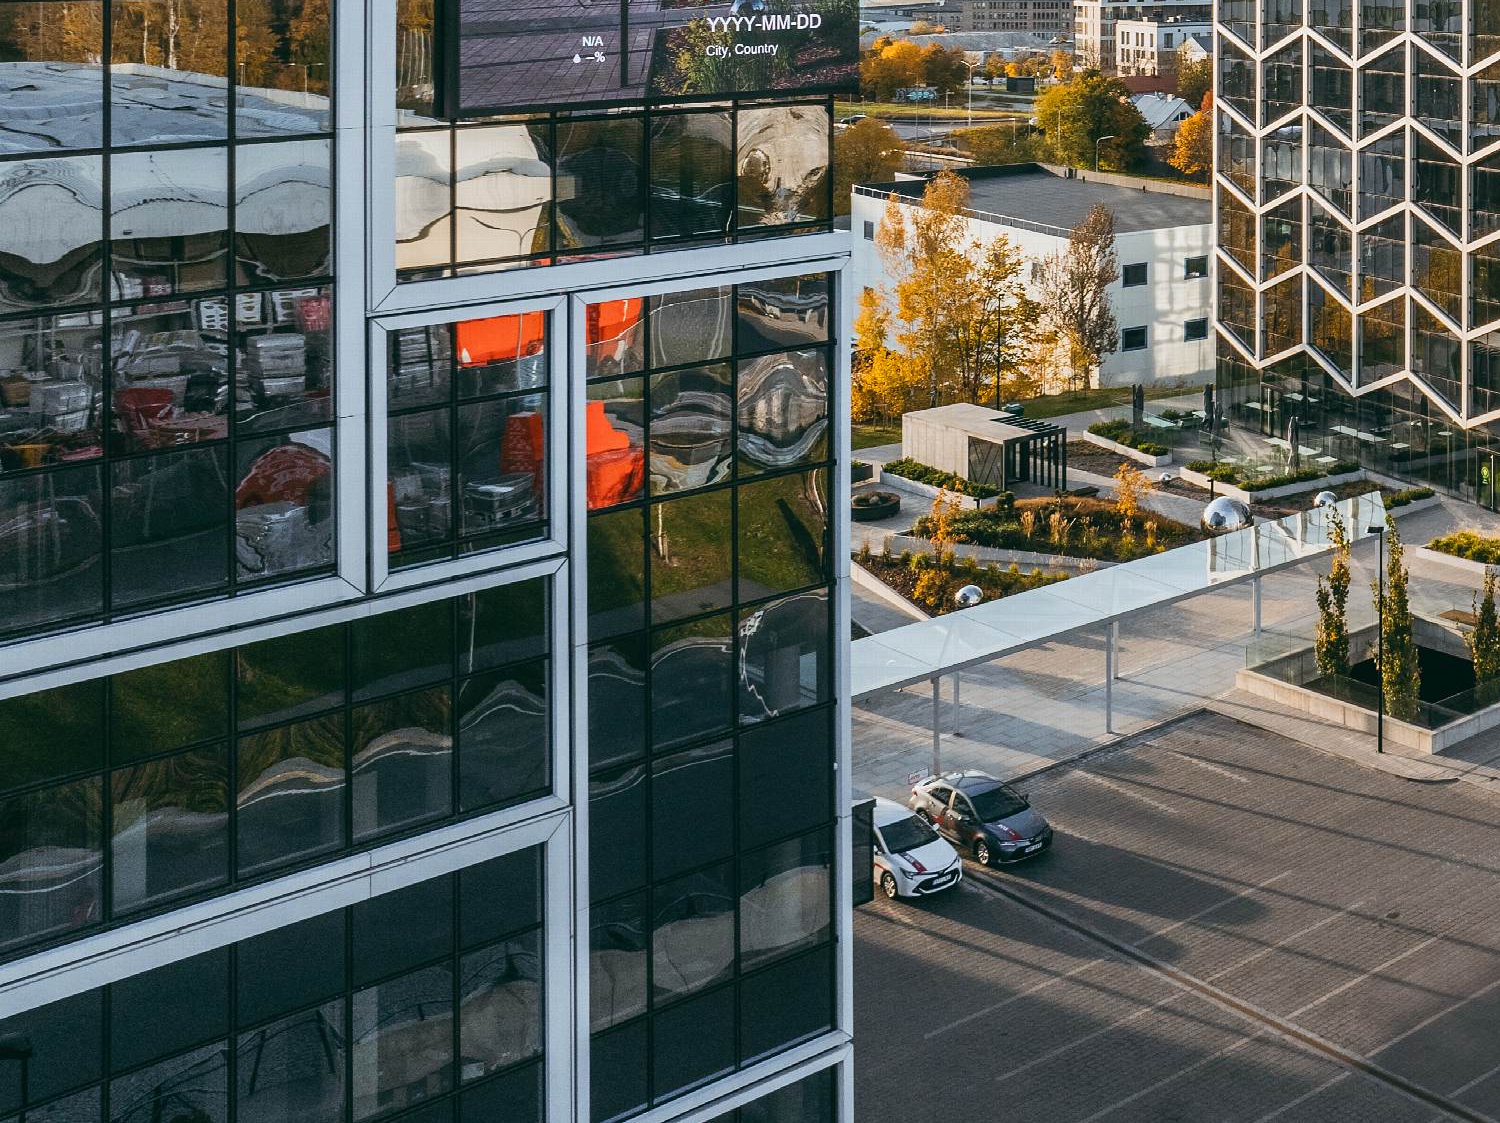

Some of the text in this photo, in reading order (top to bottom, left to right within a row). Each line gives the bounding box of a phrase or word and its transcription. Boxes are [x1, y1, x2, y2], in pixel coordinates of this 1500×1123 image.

[706, 13, 822, 33] YYYY-MM-DD
[582, 35, 604, 47] N/A
[706, 43, 779, 58] City, Country
